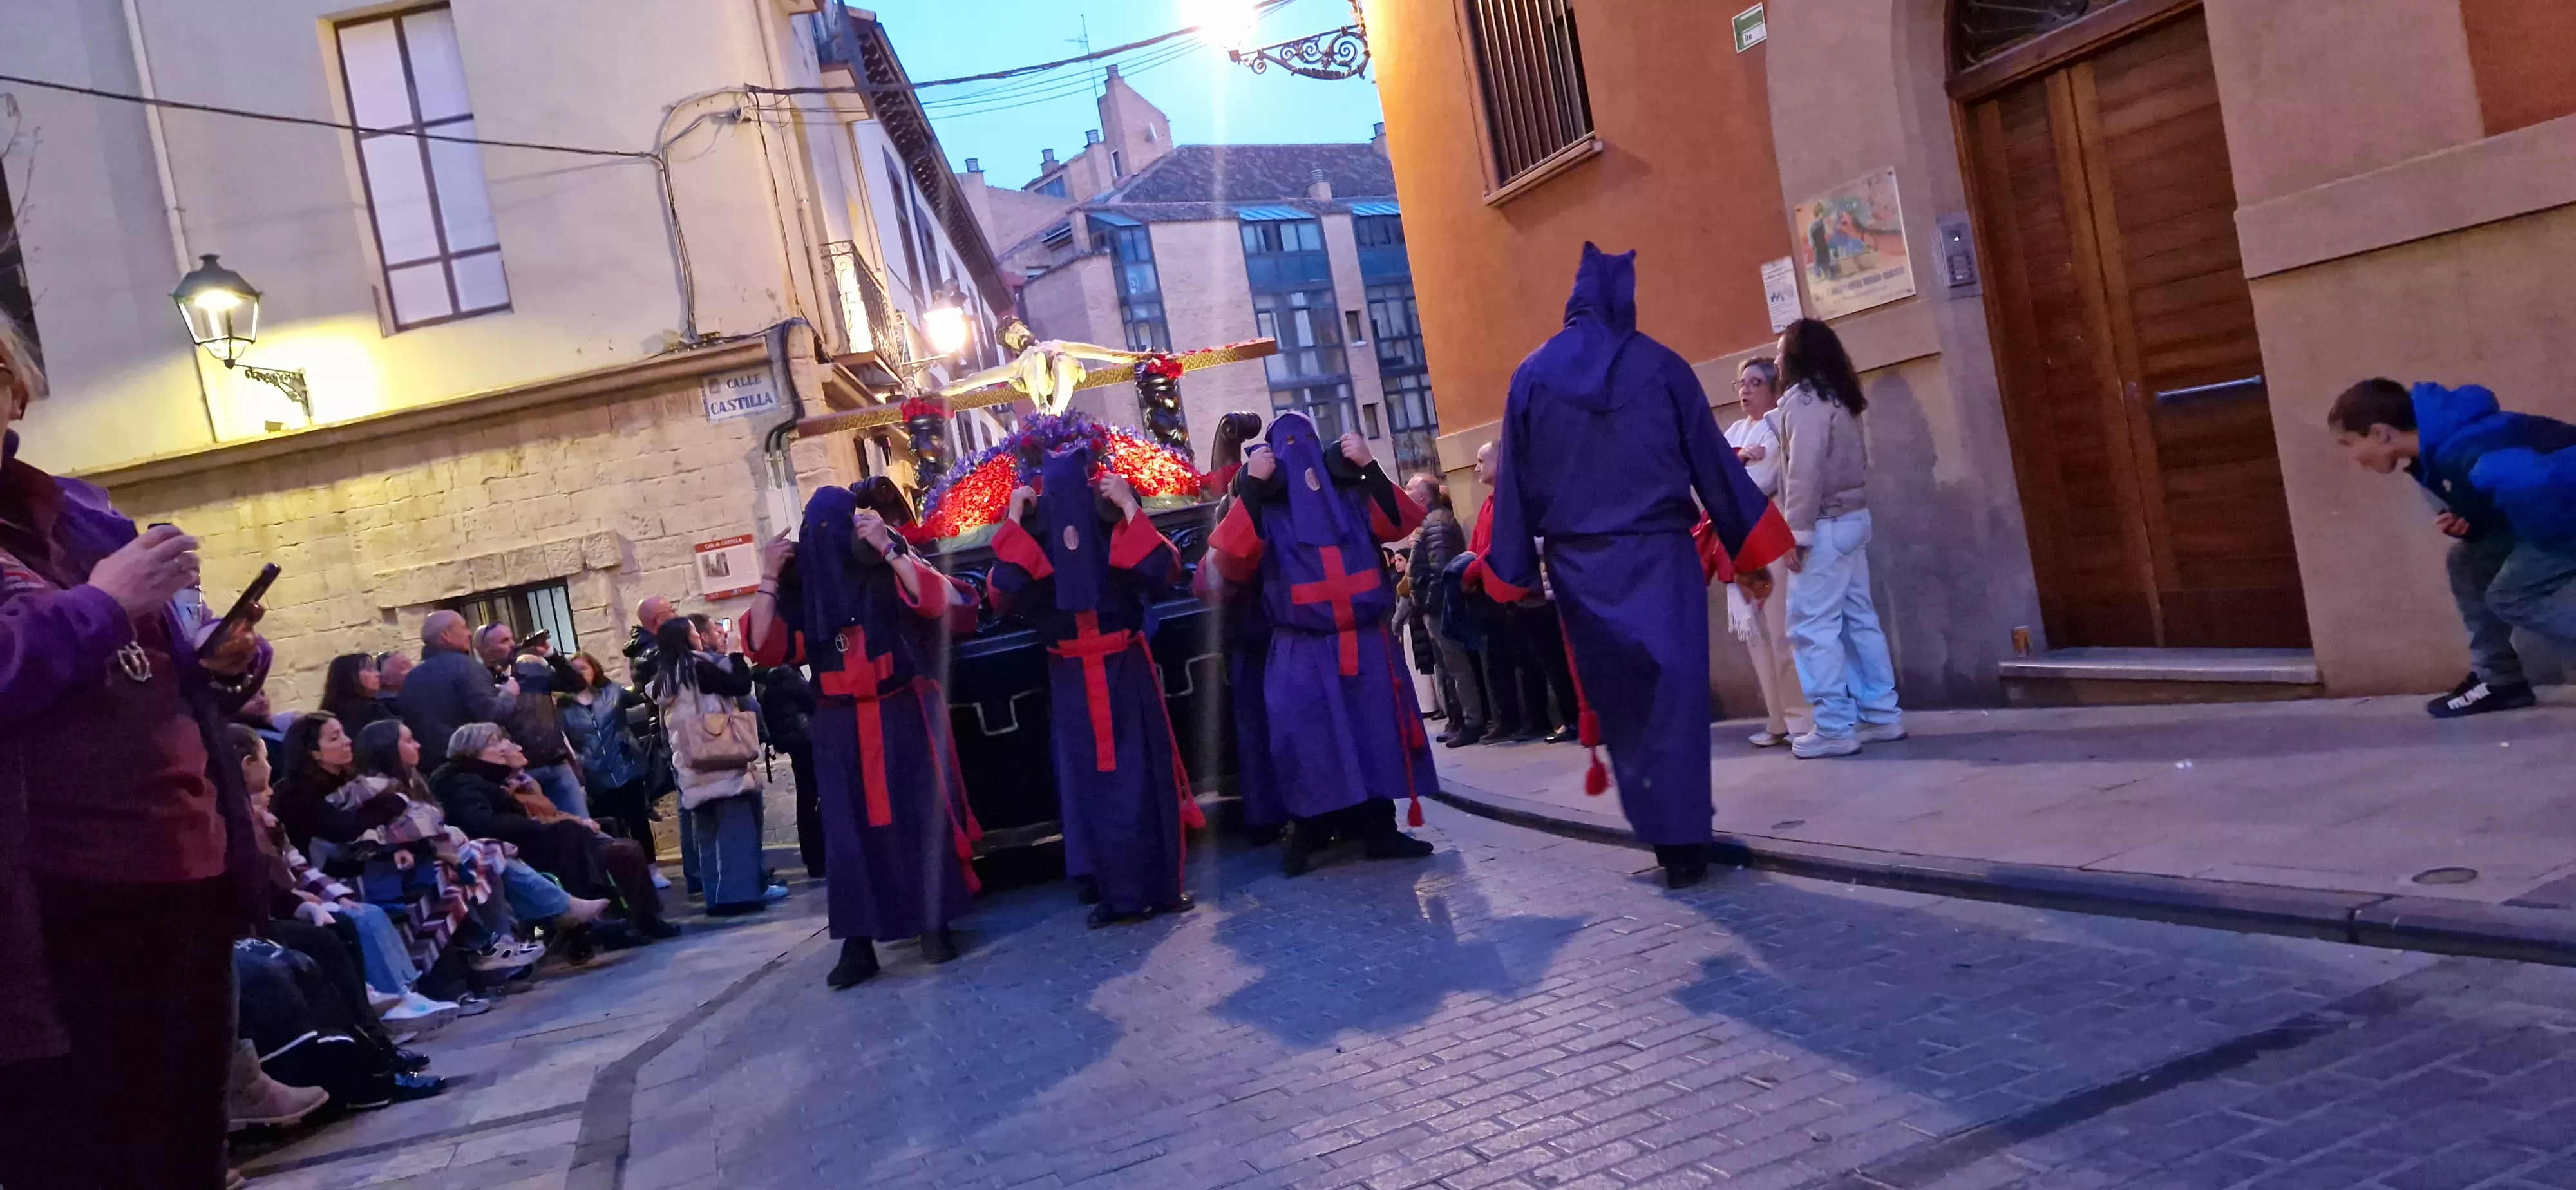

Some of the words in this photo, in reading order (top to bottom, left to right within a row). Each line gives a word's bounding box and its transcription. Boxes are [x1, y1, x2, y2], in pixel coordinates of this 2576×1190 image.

[726, 374, 761, 389] CALLE
[710, 392, 774, 415] CASTILLA
[721, 538, 743, 547] CASTILLA
